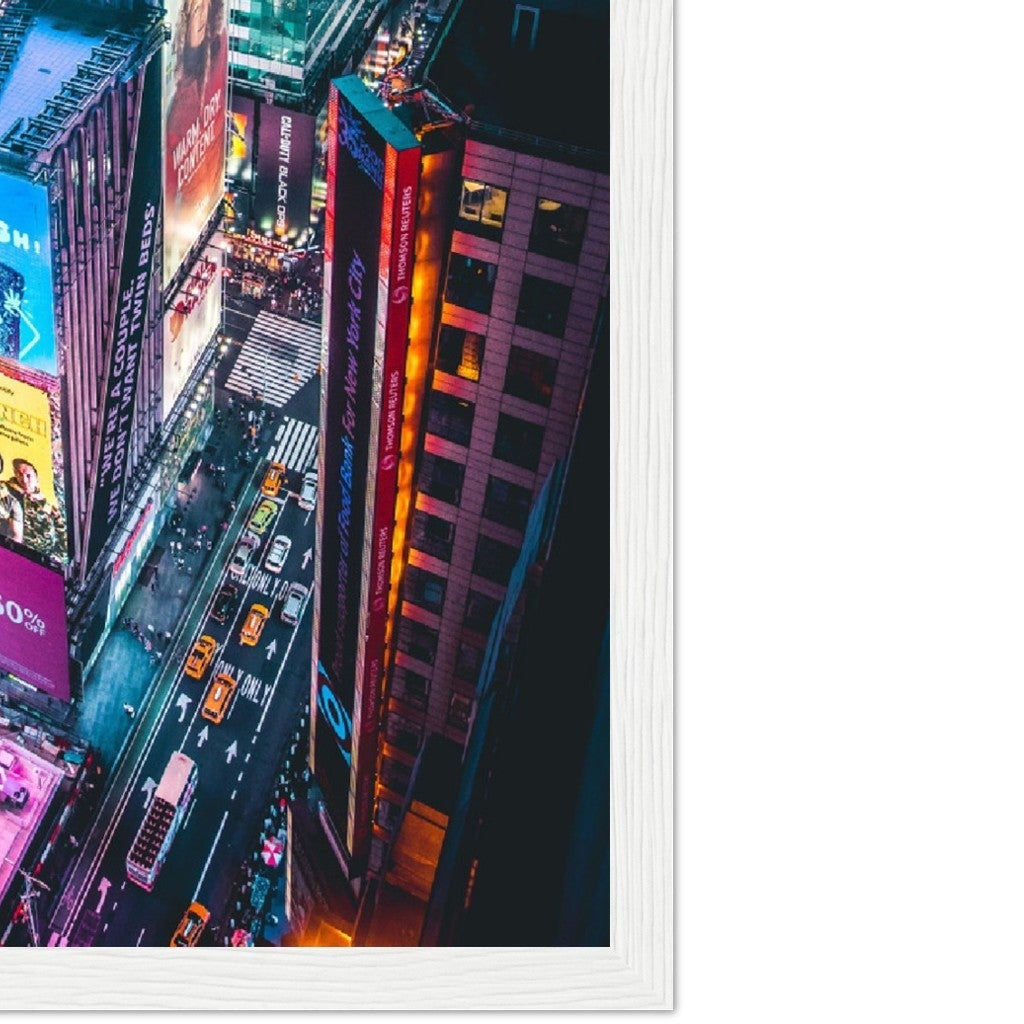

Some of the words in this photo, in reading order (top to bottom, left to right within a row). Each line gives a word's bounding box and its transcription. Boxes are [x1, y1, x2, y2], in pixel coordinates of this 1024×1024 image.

[277, 165, 288, 204] BLACK
[402, 186, 413, 231] REUTERS
[348, 249, 367, 301] City
[397, 233, 411, 281] THOMSON
[130, 271, 147, 336] TWIN
[346, 299, 363, 350] York
[113, 278, 135, 377] COUPLE.
[110, 380, 122, 398] A
[120, 342, 138, 410] WANT
[344, 349, 359, 404] New
[389, 370, 400, 407] REUTERS
[342, 400, 357, 439] For
[385, 408, 397, 451] THOMSON
[112, 414, 129, 483] DON'T
[340, 435, 354, 490] Bank
[106, 483, 121, 524] WE
[252, 570, 279, 598] ONLY
[24, 621, 46, 637] OFF
[240, 674, 273, 707] ONLY
